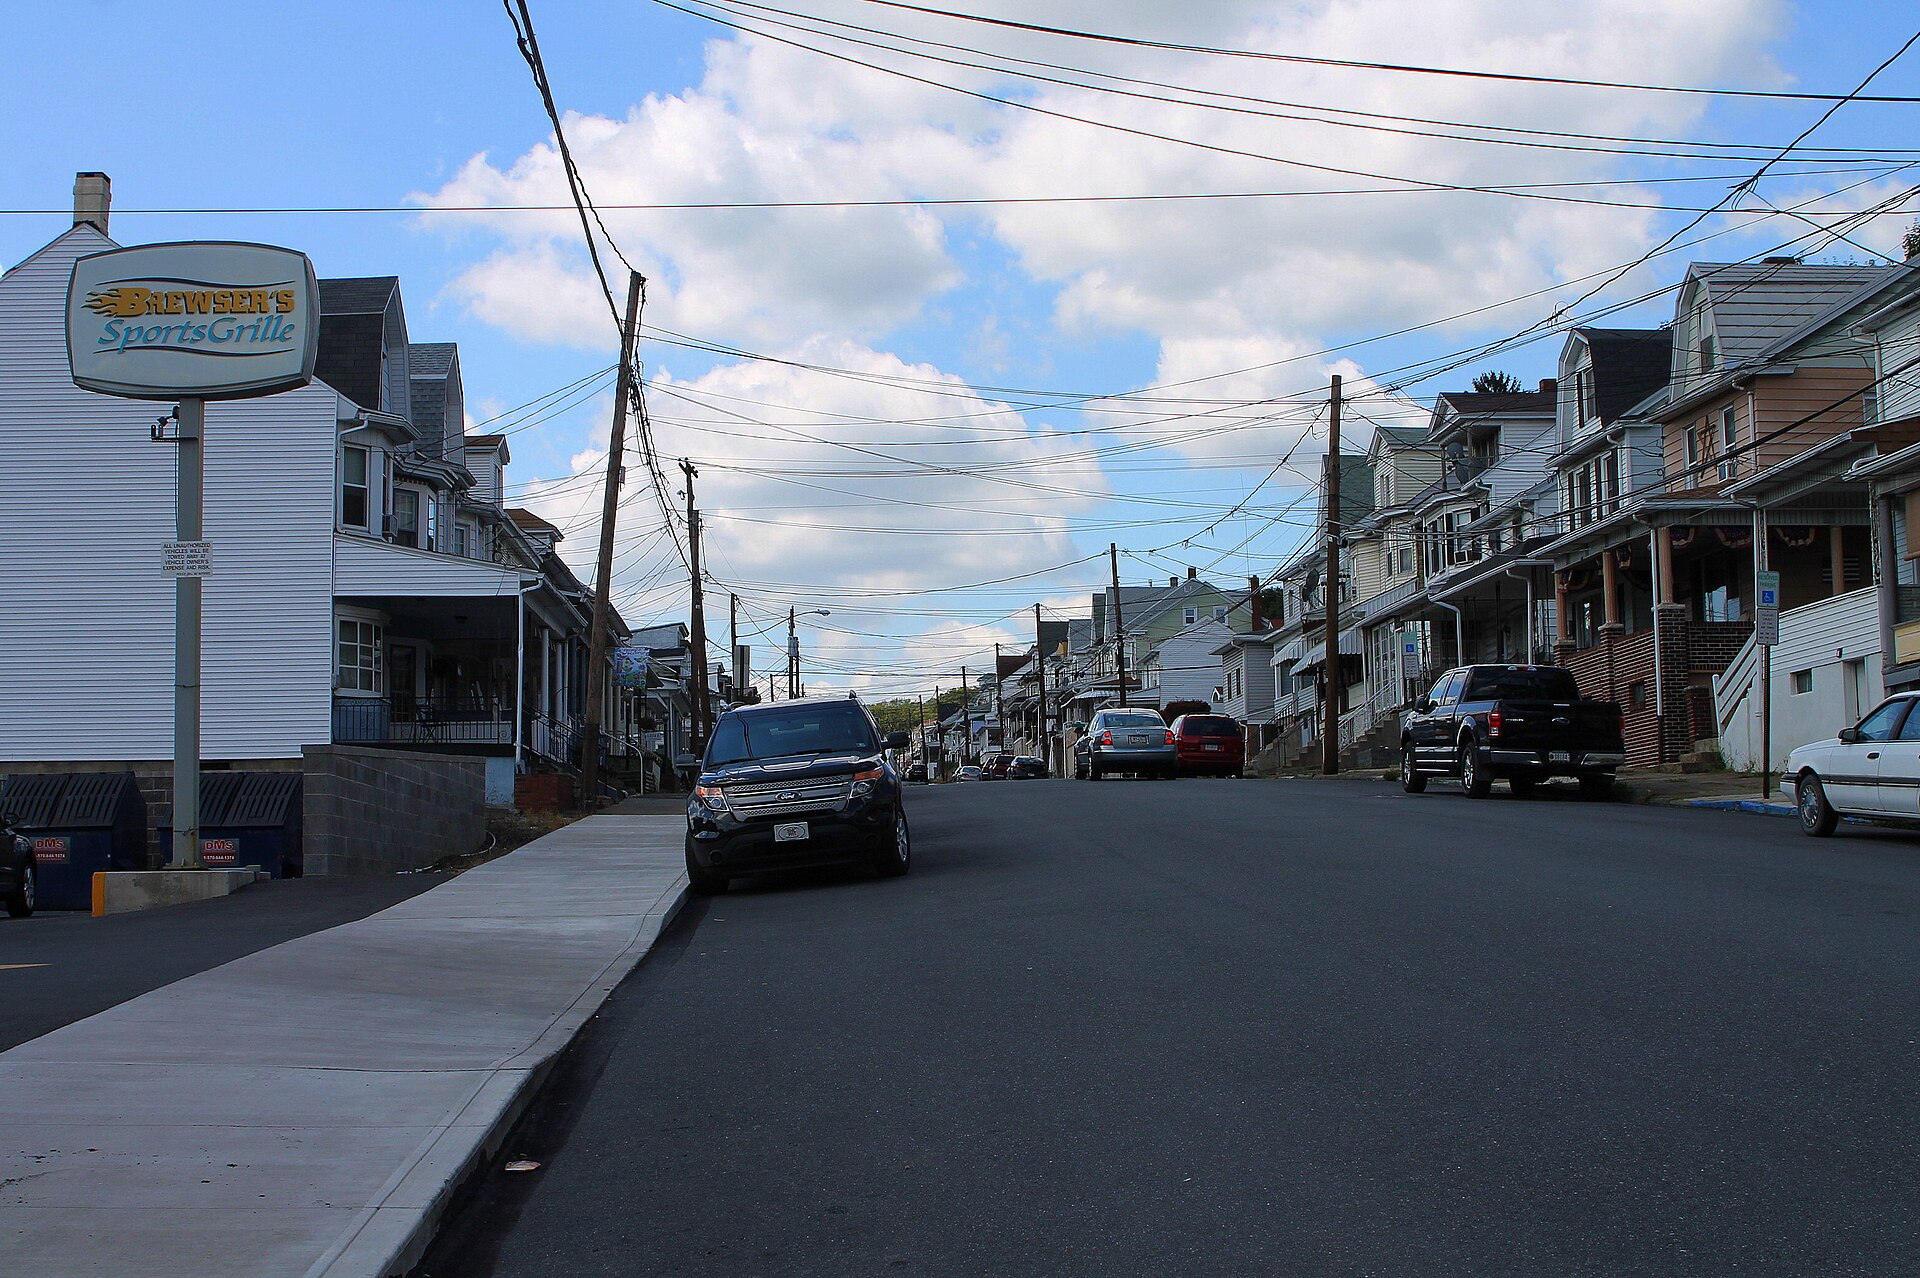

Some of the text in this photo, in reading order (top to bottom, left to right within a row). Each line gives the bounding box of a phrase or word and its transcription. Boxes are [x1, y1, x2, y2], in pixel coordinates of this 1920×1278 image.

[82, 287, 295, 317] BREWSER'S
[35, 837, 65, 849] DMS
[204, 839, 234, 851] DMS
